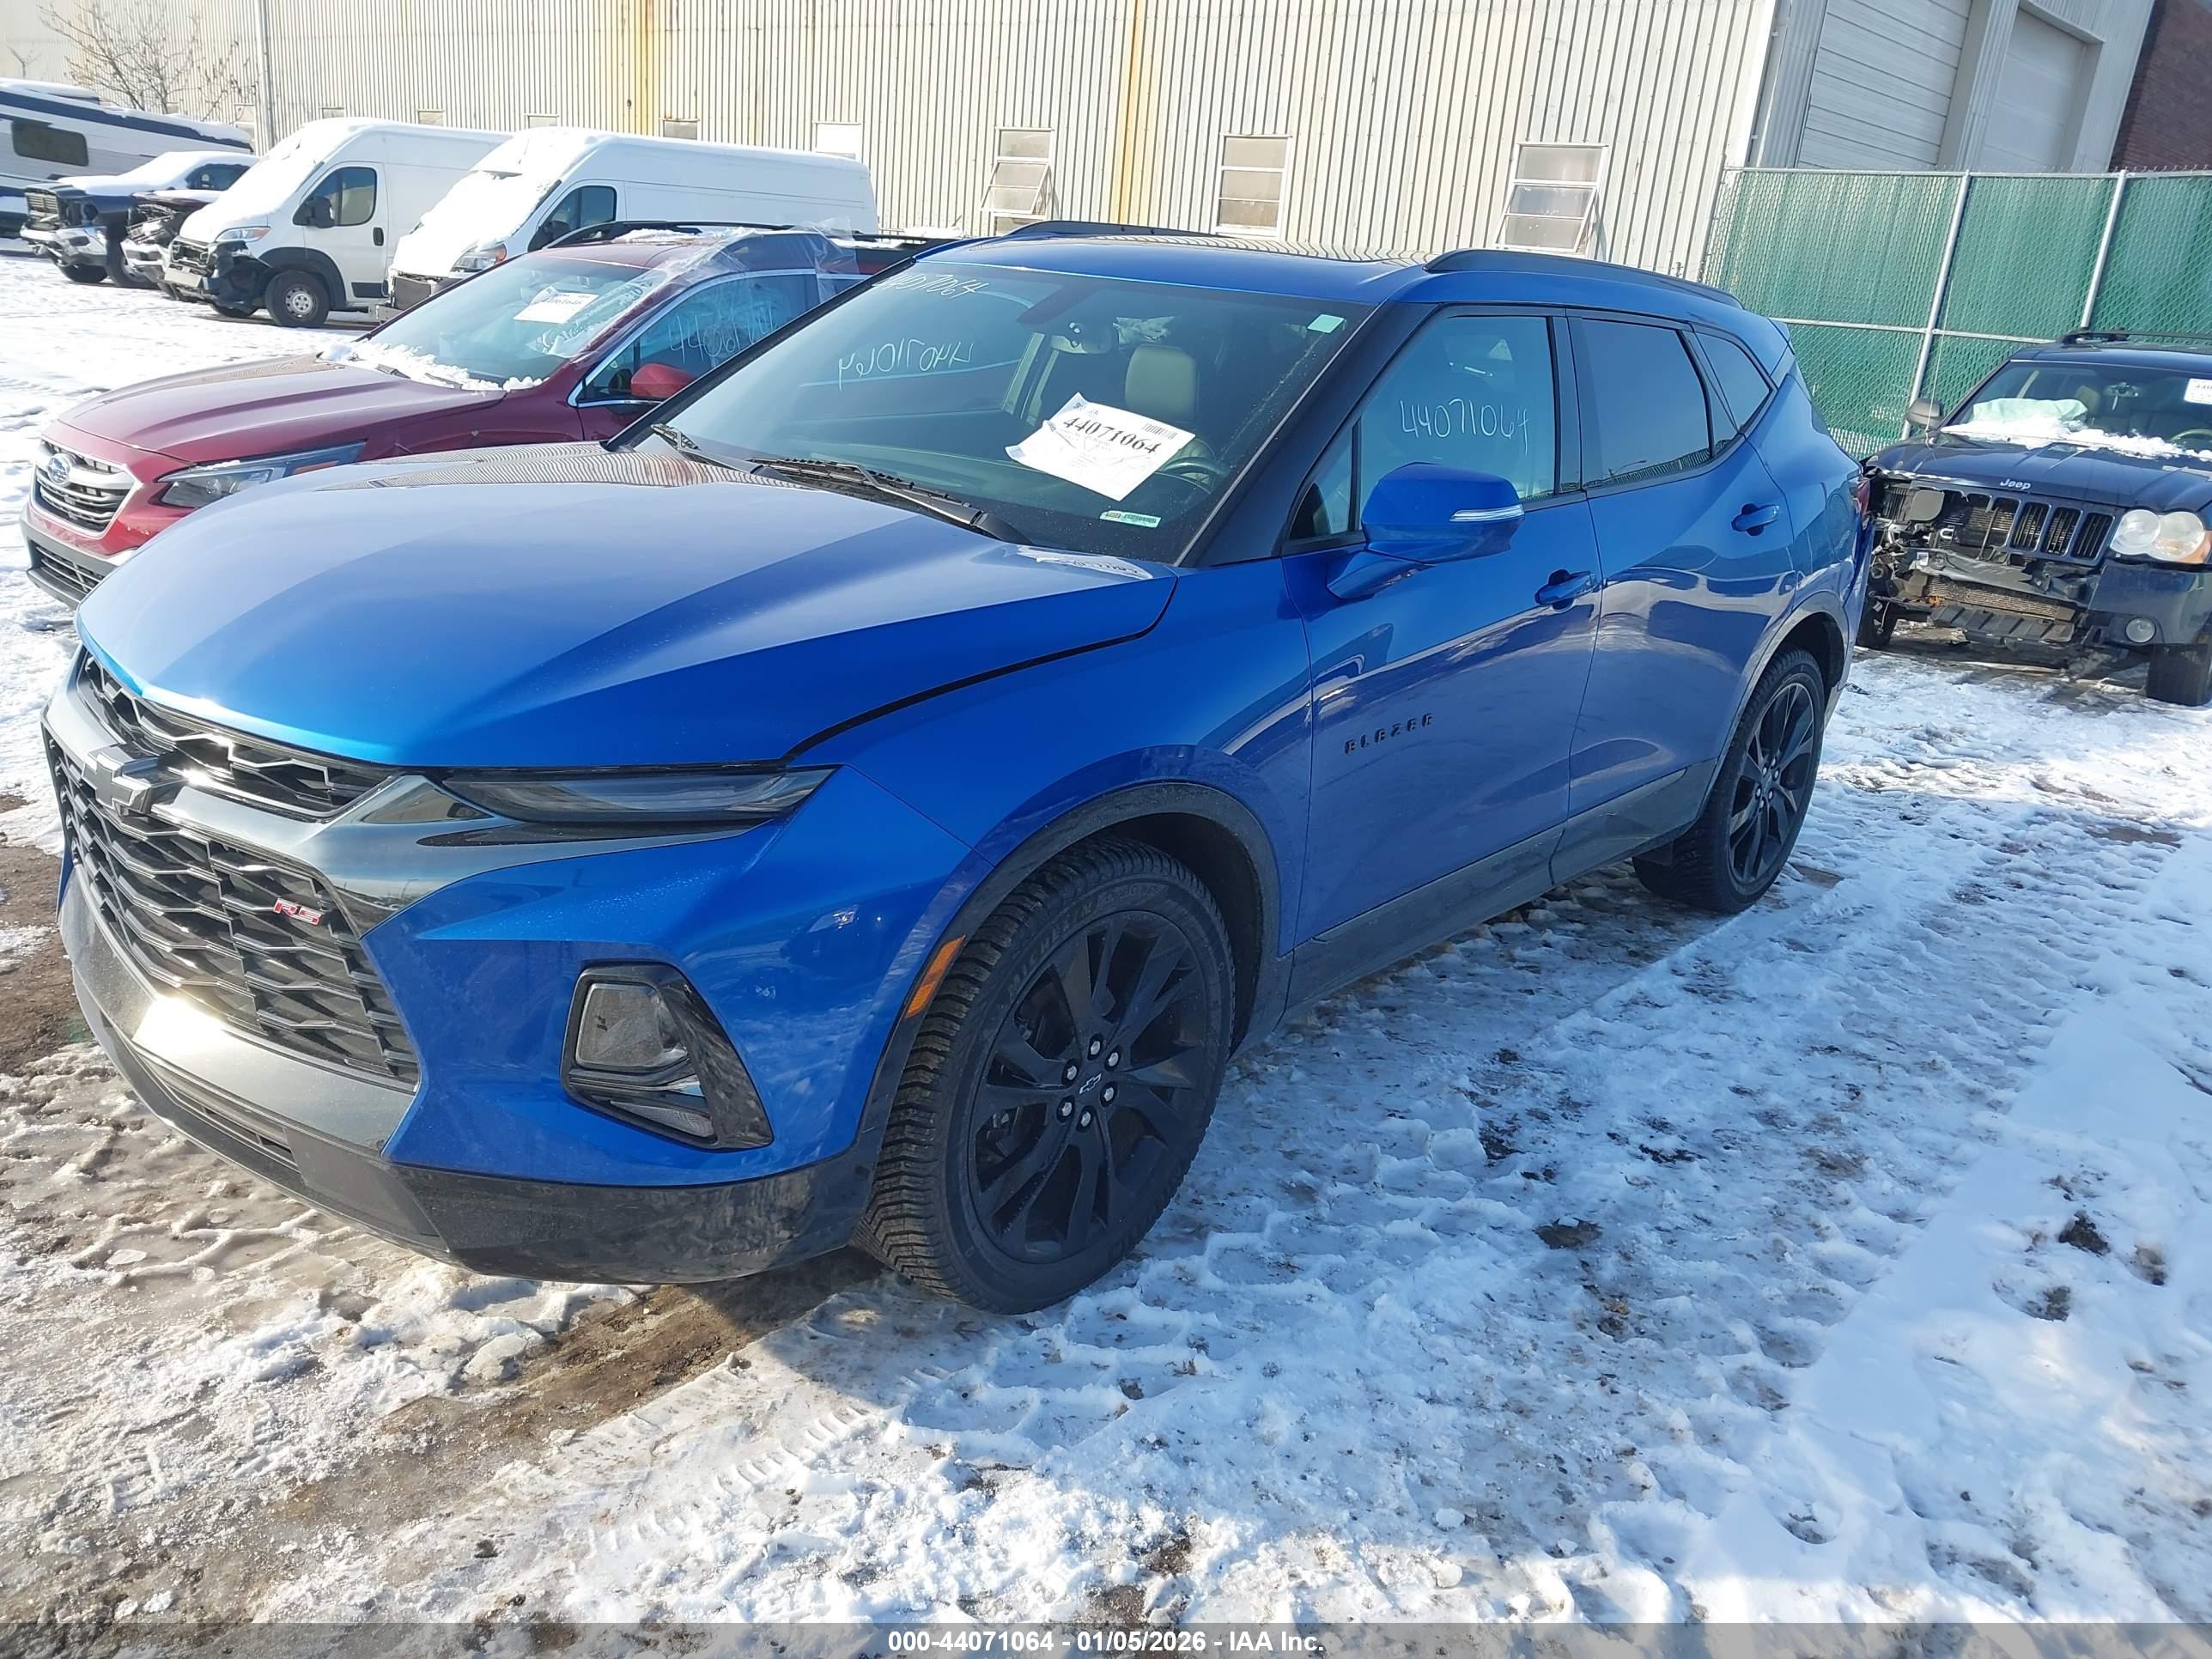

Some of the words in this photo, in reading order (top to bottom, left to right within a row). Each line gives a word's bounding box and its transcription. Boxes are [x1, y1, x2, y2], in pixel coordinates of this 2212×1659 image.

[1063, 417, 1162, 453] 44071064
[1400, 398, 1530, 456] 44071064
[1999, 478, 2032, 490] Jeep
[1344, 713, 1433, 754] BLAZER
[274, 897, 323, 926] RS
